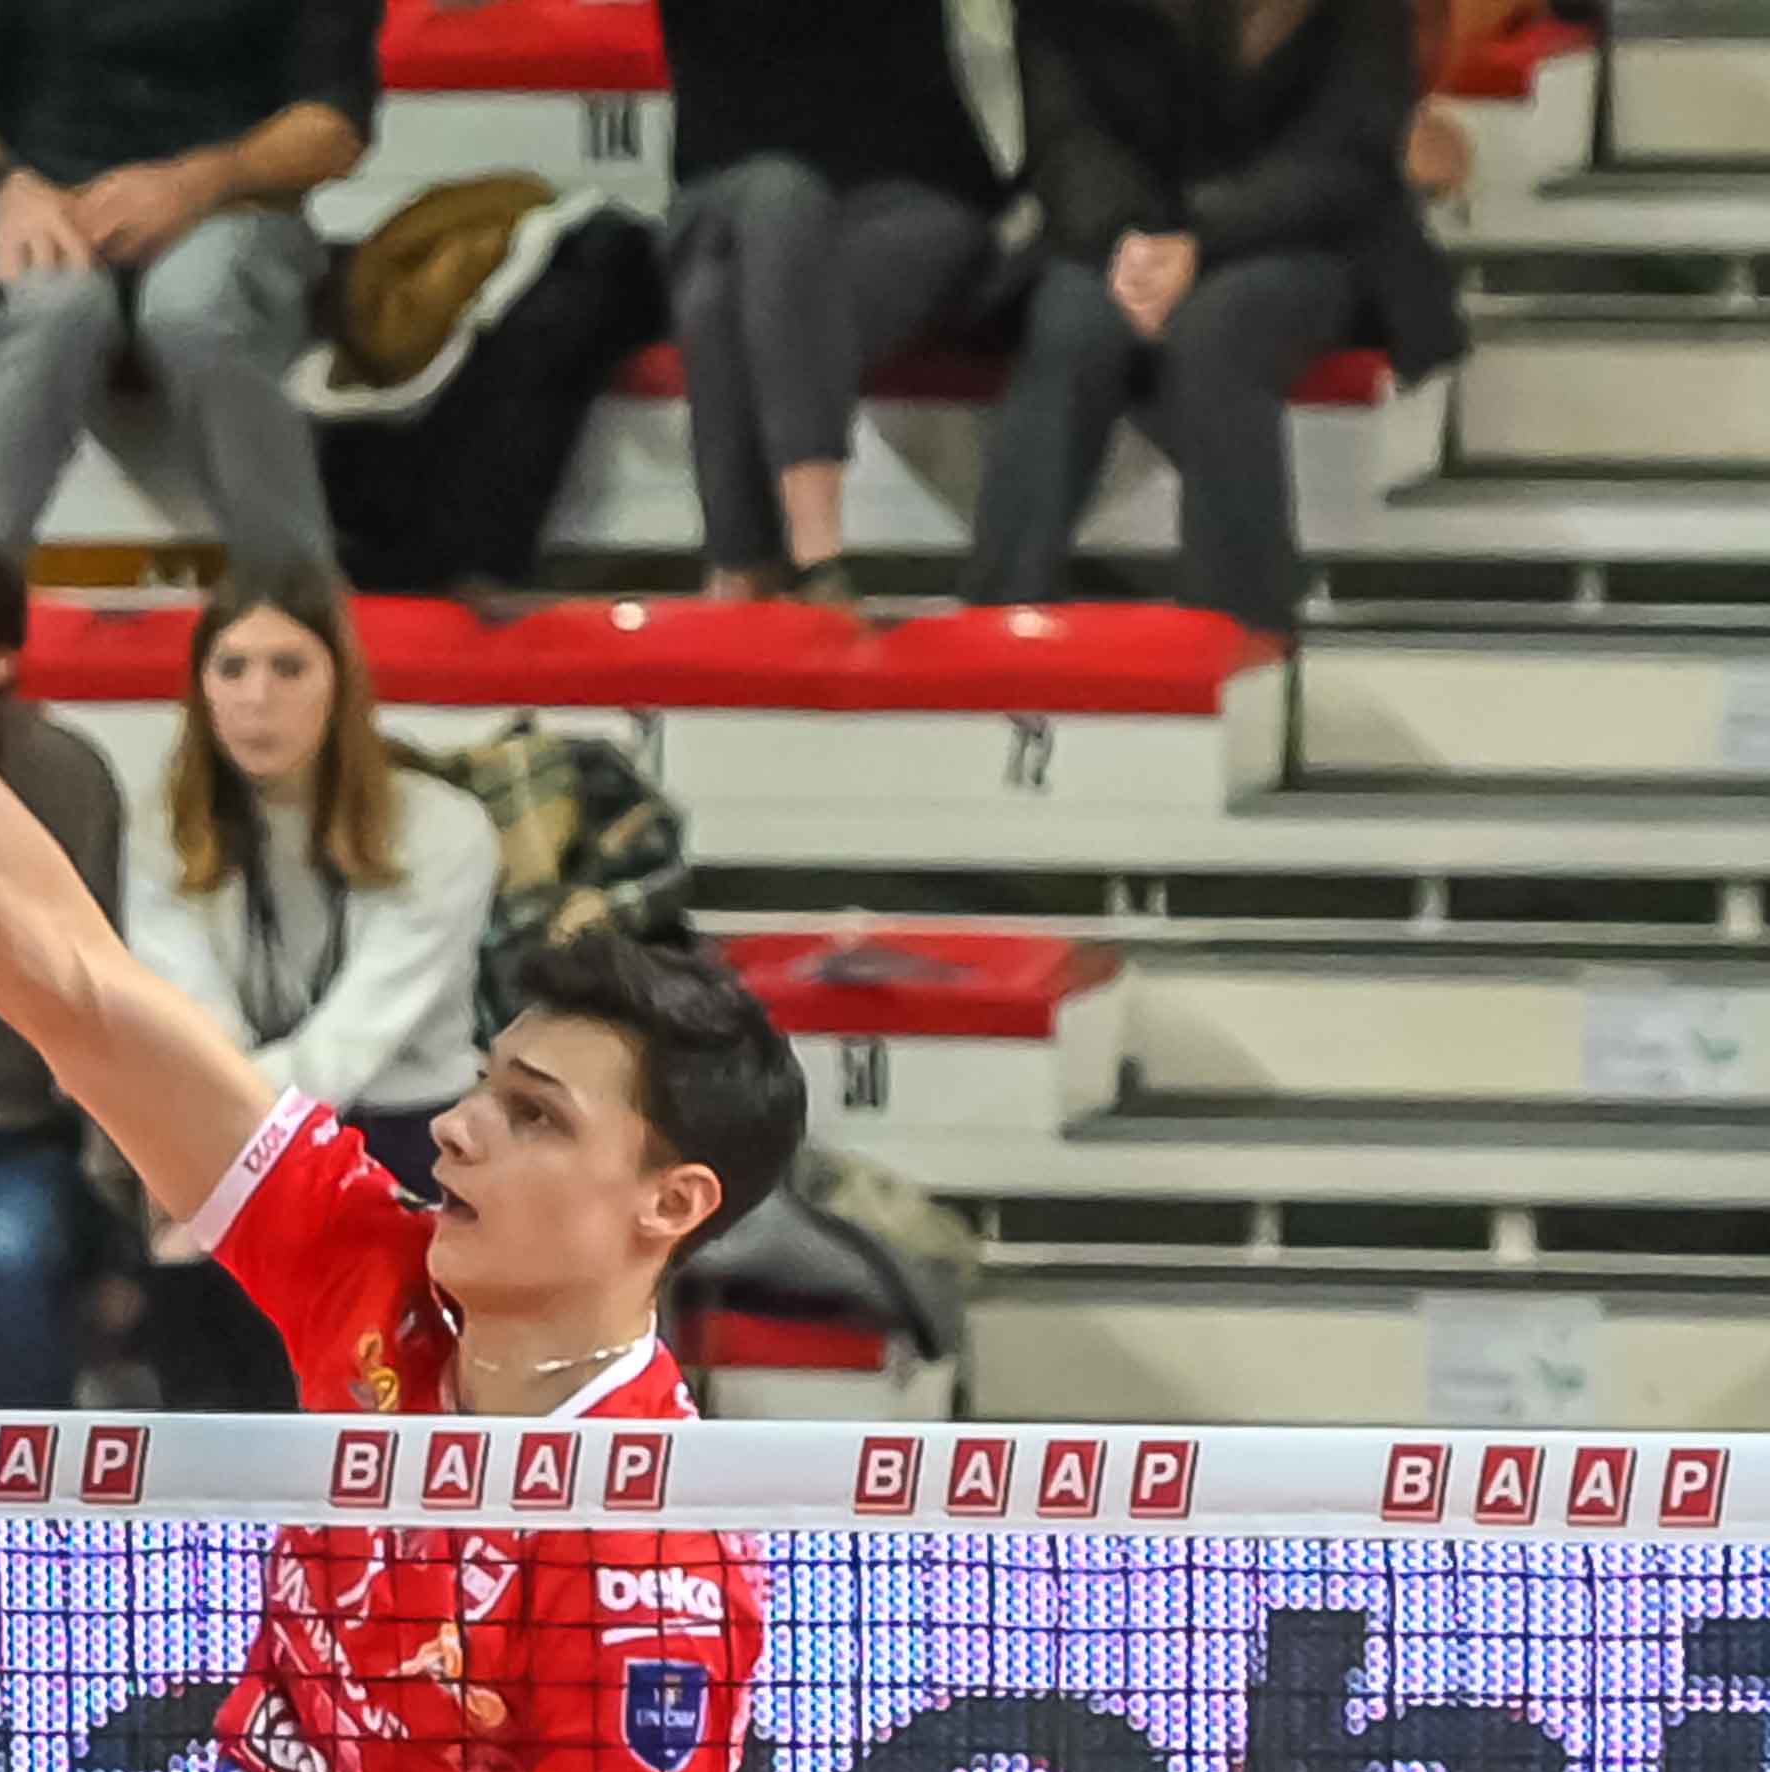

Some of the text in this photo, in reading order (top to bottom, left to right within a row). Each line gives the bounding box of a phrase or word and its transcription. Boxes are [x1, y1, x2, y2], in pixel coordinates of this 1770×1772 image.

[335, 1434, 660, 1500] BAAP
[861, 1443, 1189, 1508] BAAP
[1387, 1450, 1717, 1516] BAAP
